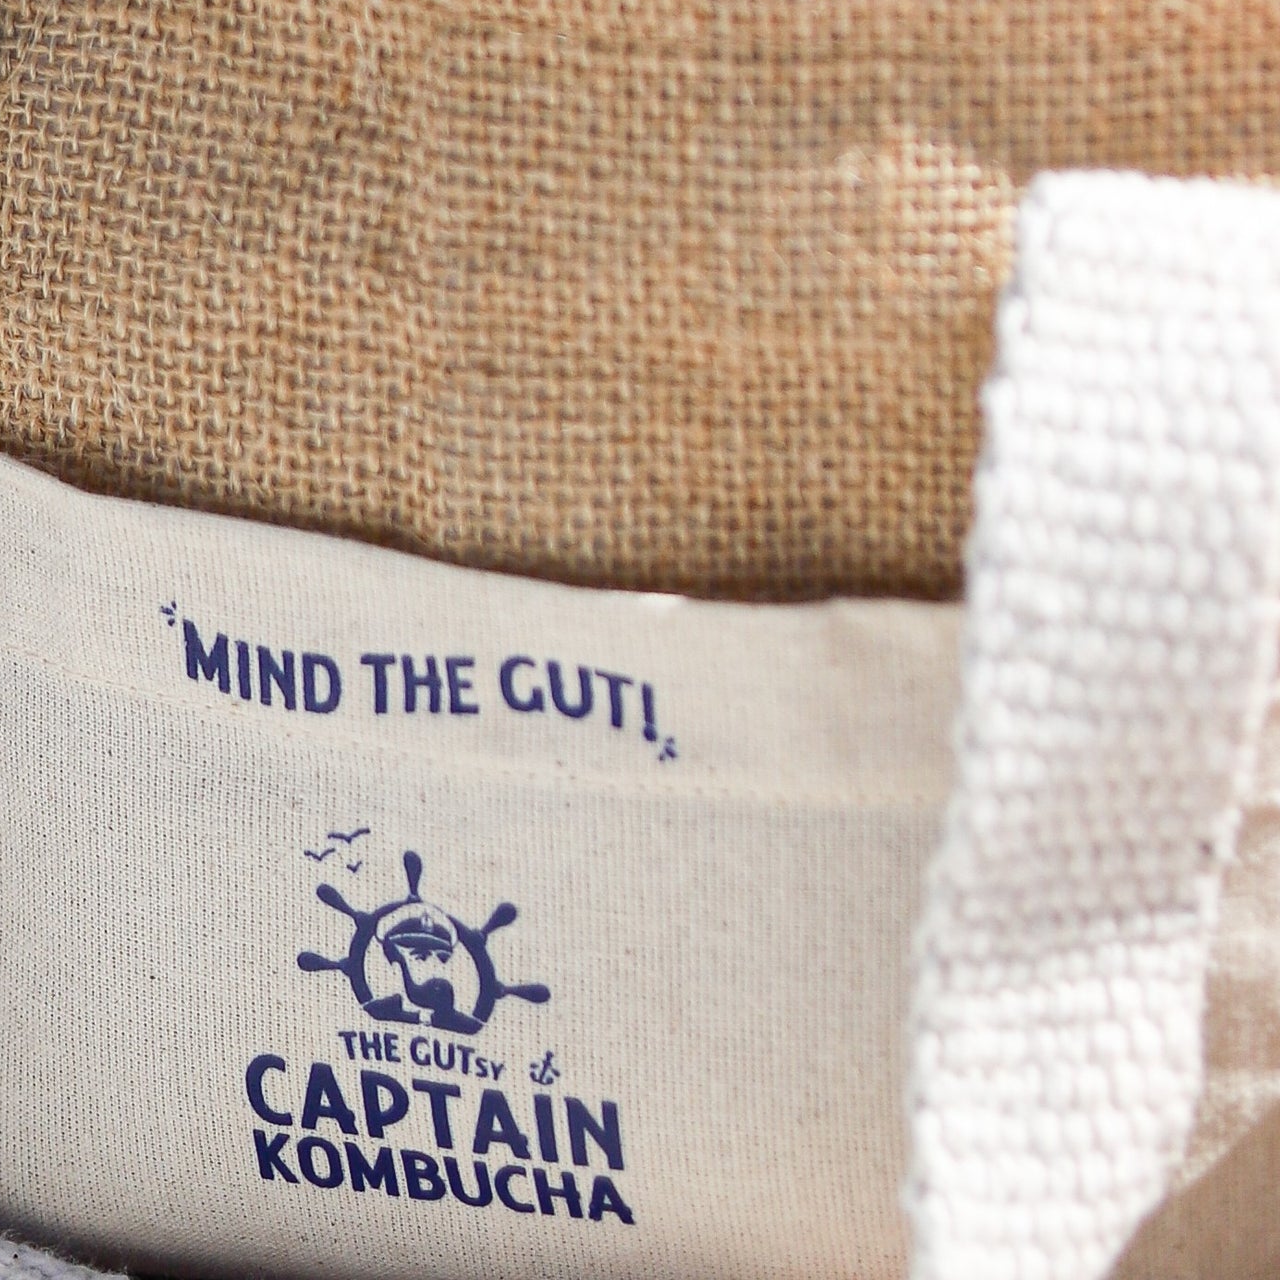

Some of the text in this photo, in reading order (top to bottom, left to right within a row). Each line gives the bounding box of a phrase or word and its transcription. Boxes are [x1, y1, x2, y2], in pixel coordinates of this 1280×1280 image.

[181, 618, 659, 742] MIND THE GUT!
[337, 1030, 402, 1064] THE
[245, 1053, 625, 1170] CAPTAIN
[253, 1128, 636, 1224] KOMBUCHA
